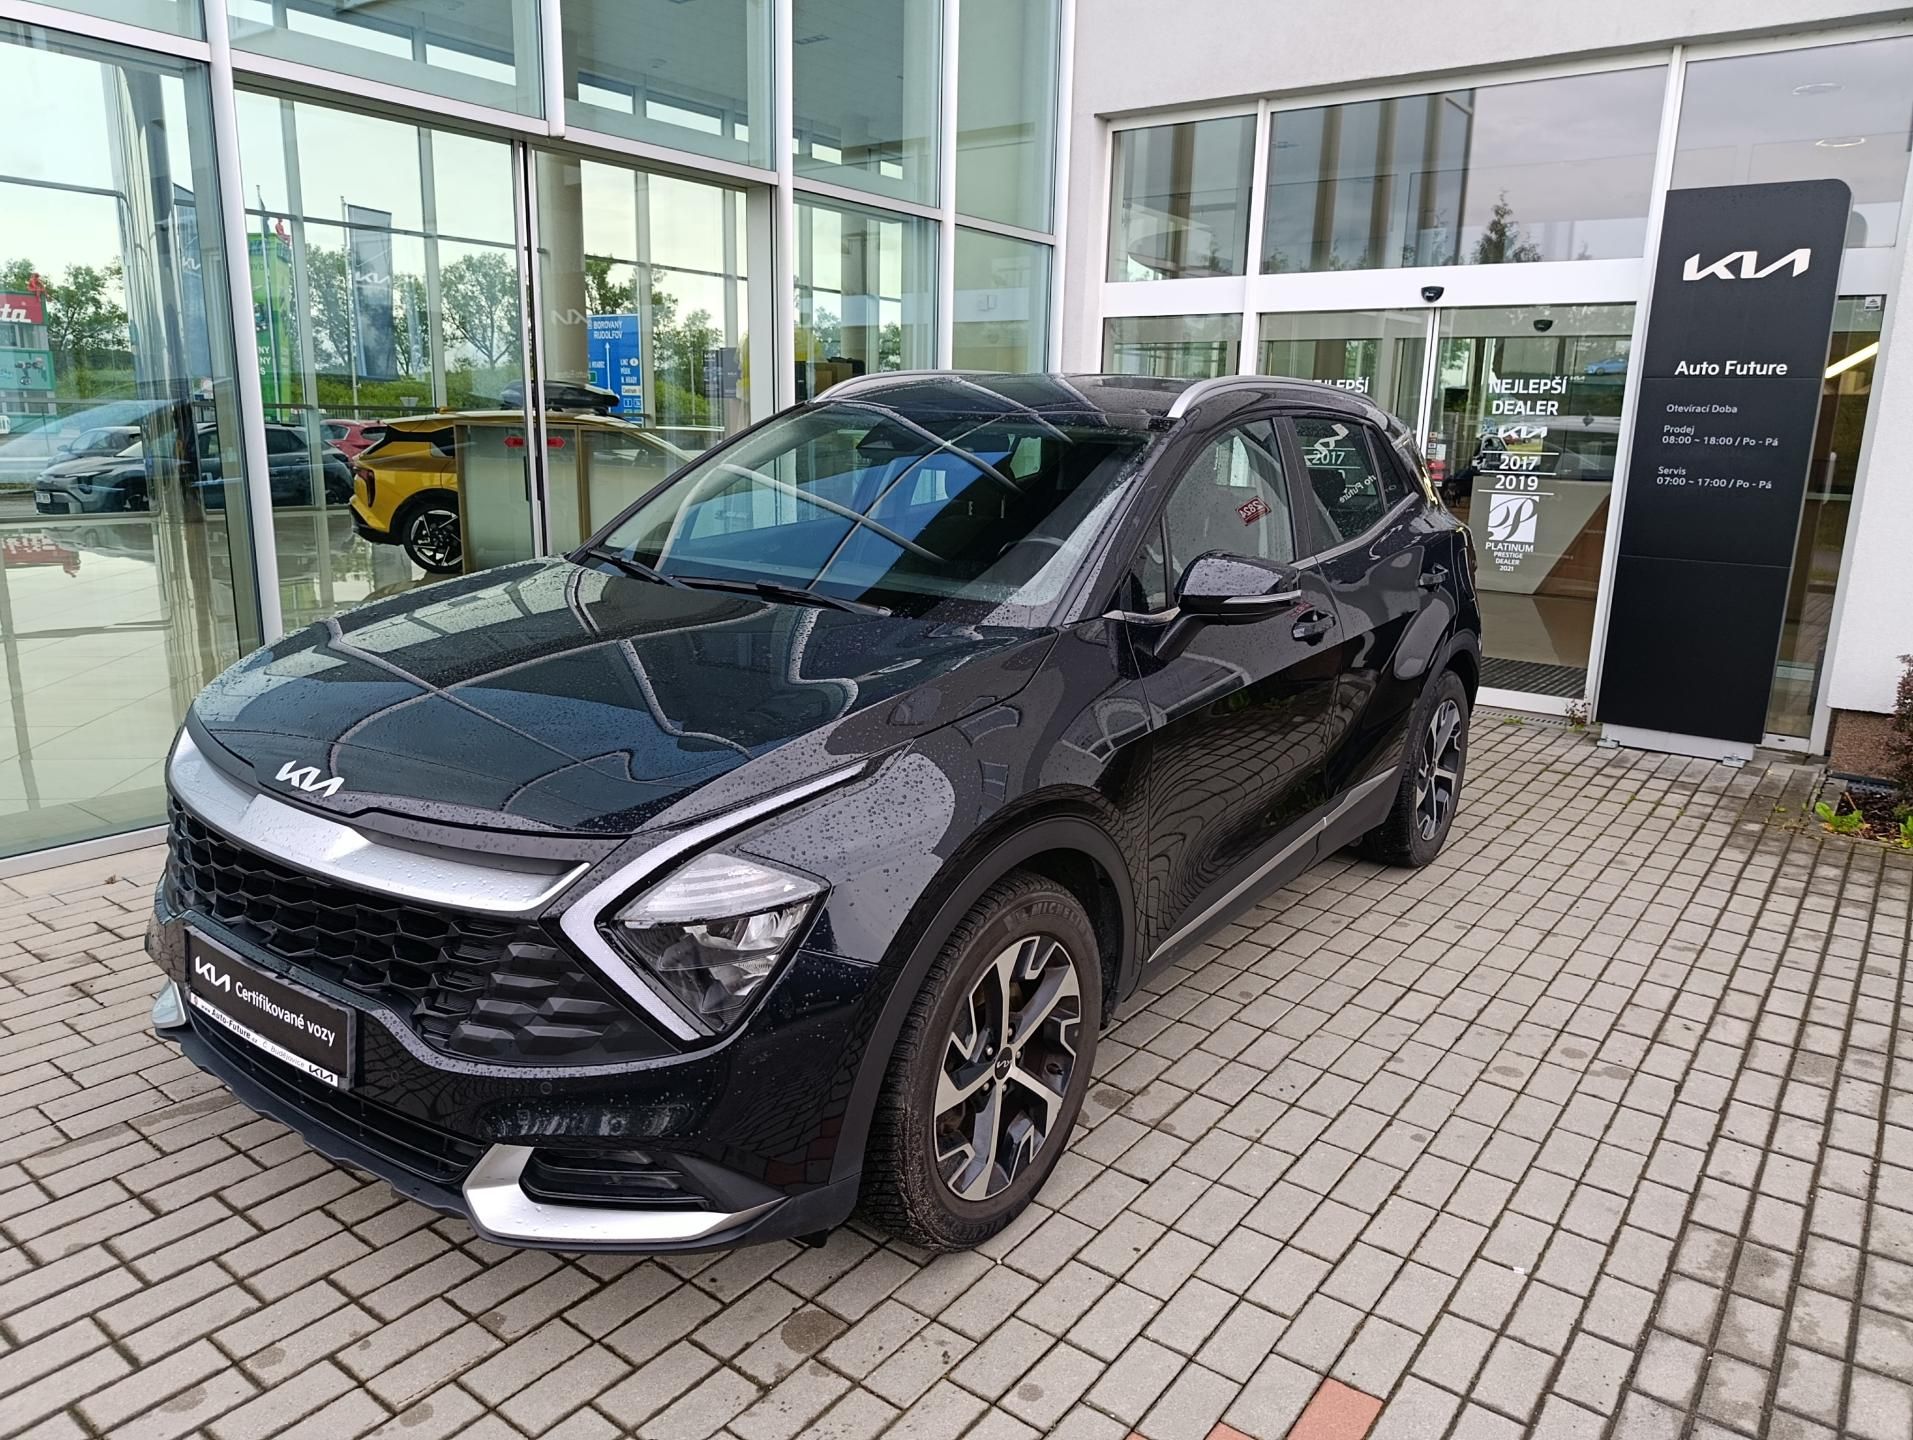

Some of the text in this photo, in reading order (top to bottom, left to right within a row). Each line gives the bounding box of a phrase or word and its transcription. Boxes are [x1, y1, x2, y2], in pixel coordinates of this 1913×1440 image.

[1683, 248, 1811, 281] KIA
[355, 271, 390, 285] KIA
[593, 320, 622, 330] BOROVANY
[593, 331, 622, 339] RUDOLFOV
[1674, 360, 1788, 376] Auto Future
[1488, 376, 1568, 394] NEJLEPŠÍ
[1492, 400, 1558, 415] DEALER
[1666, 403, 1738, 414] Otevírací Doba
[1498, 426, 1548, 439] KIA
[1663, 425, 1695, 435] Prodej
[1662, 435, 1692, 444] 08:00
[1703, 436, 1733, 445] 18:00
[1742, 437, 1756, 446] Po
[1765, 438, 1779, 446] Pá
[1312, 451, 1345, 465] 2017
[1499, 455, 1538, 470] 2017
[1657, 466, 1687, 475] Servis
[1495, 474, 1539, 490] 2019
[1656, 477, 1686, 486] 07:00
[1697, 478, 1727, 487] 17:00
[1736, 480, 1750, 488] Po
[1758, 481, 1772, 489] Pá
[1485, 542, 1534, 553] PLATINUM
[1493, 551, 1523, 559] PRESTIGE
[275, 760, 345, 798] KIA
[195, 956, 231, 992] KIA
[235, 981, 336, 1047] Certifikované vozy
[309, 1065, 334, 1083] KIA
